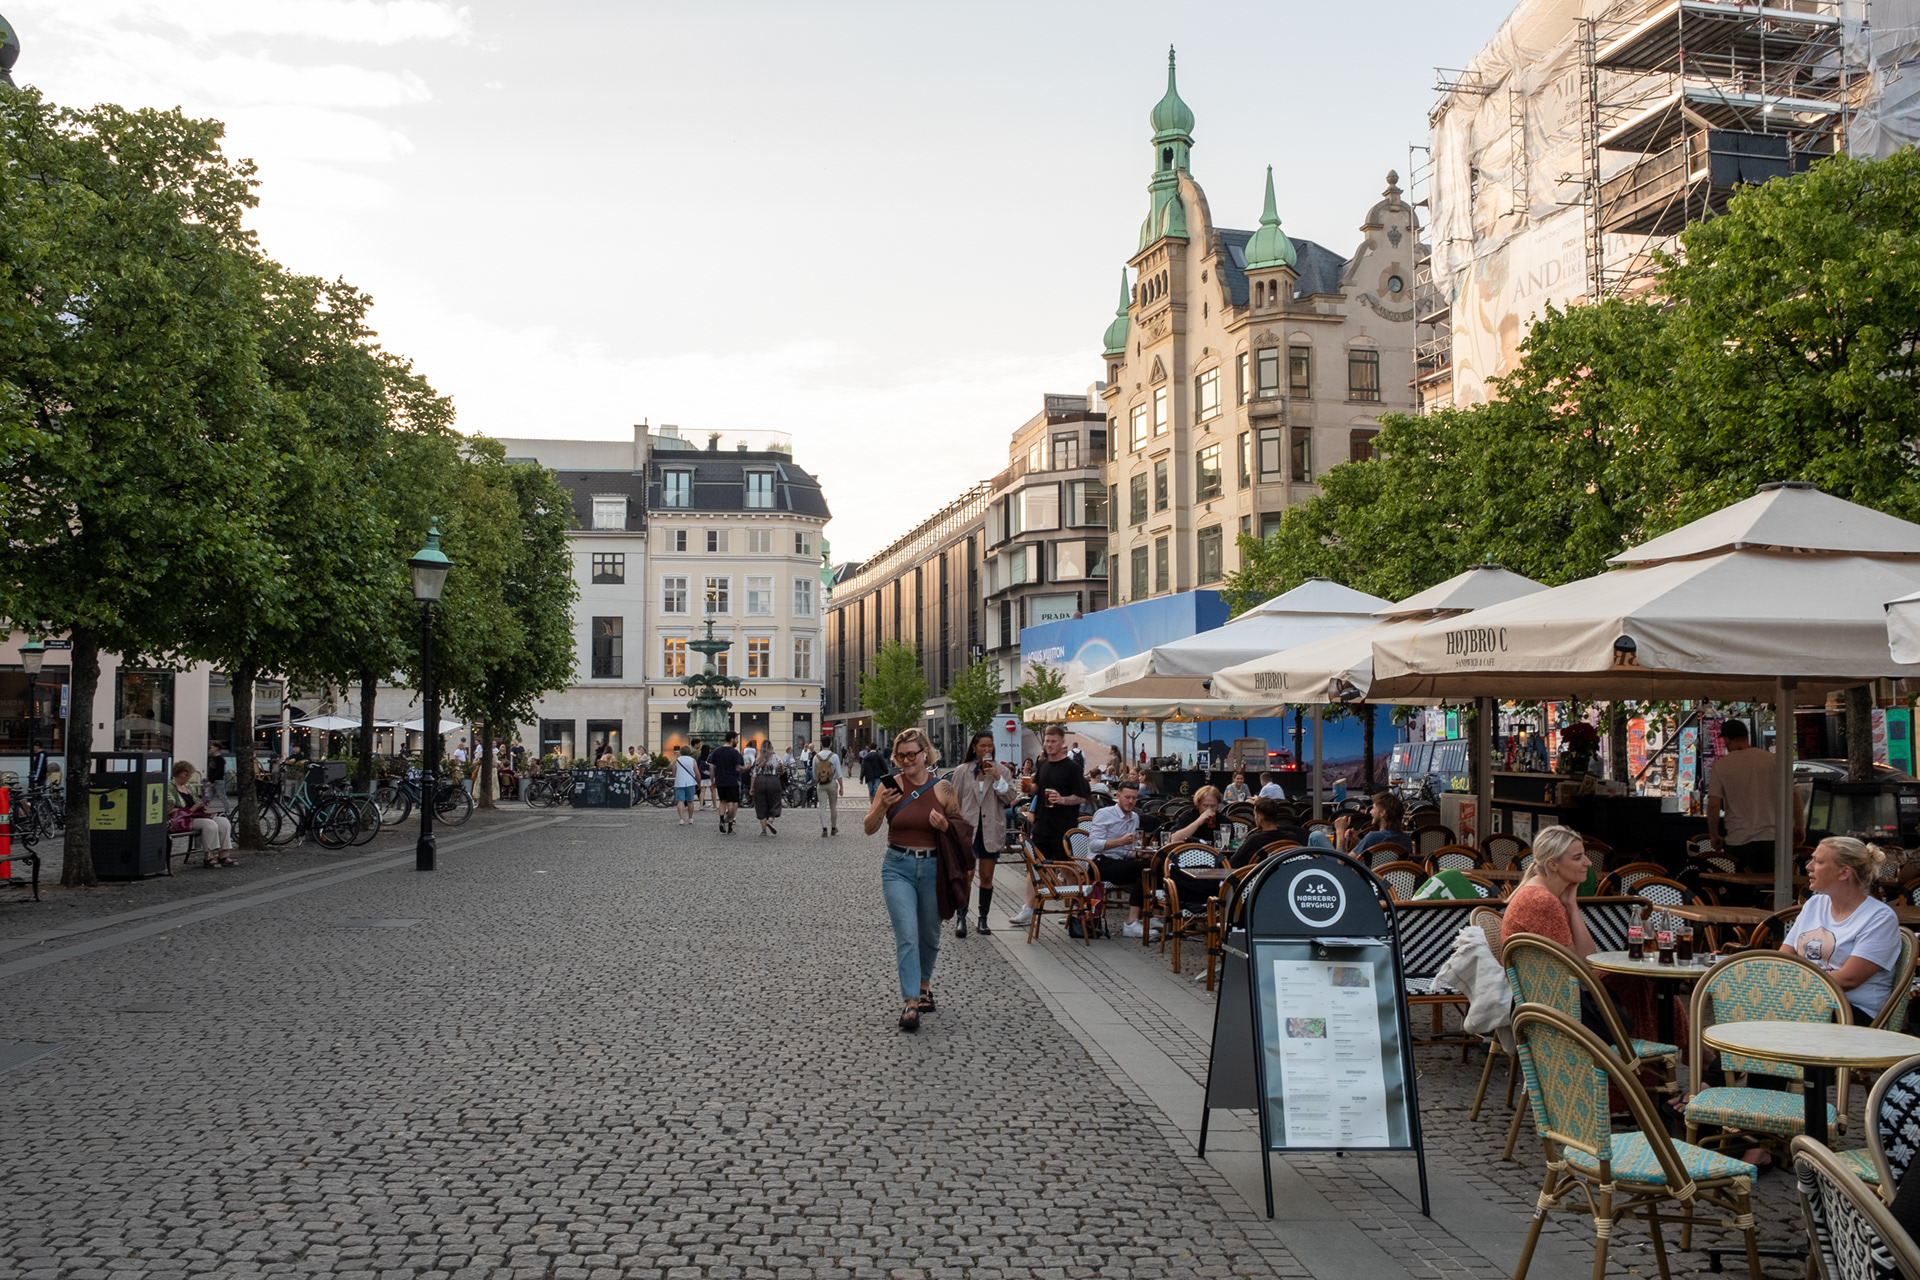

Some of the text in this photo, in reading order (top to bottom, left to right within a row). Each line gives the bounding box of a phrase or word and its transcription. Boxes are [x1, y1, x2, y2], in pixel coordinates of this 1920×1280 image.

[1562, 260, 1582, 280] LIKE
[1513, 259, 1561, 304] AND
[1041, 612, 1070, 621] PRADA
[1445, 626, 1508, 657] HØJBRO C
[1027, 645, 1065, 663] LOUIS VUITTON
[1254, 672, 1289, 691] HØJBRO C
